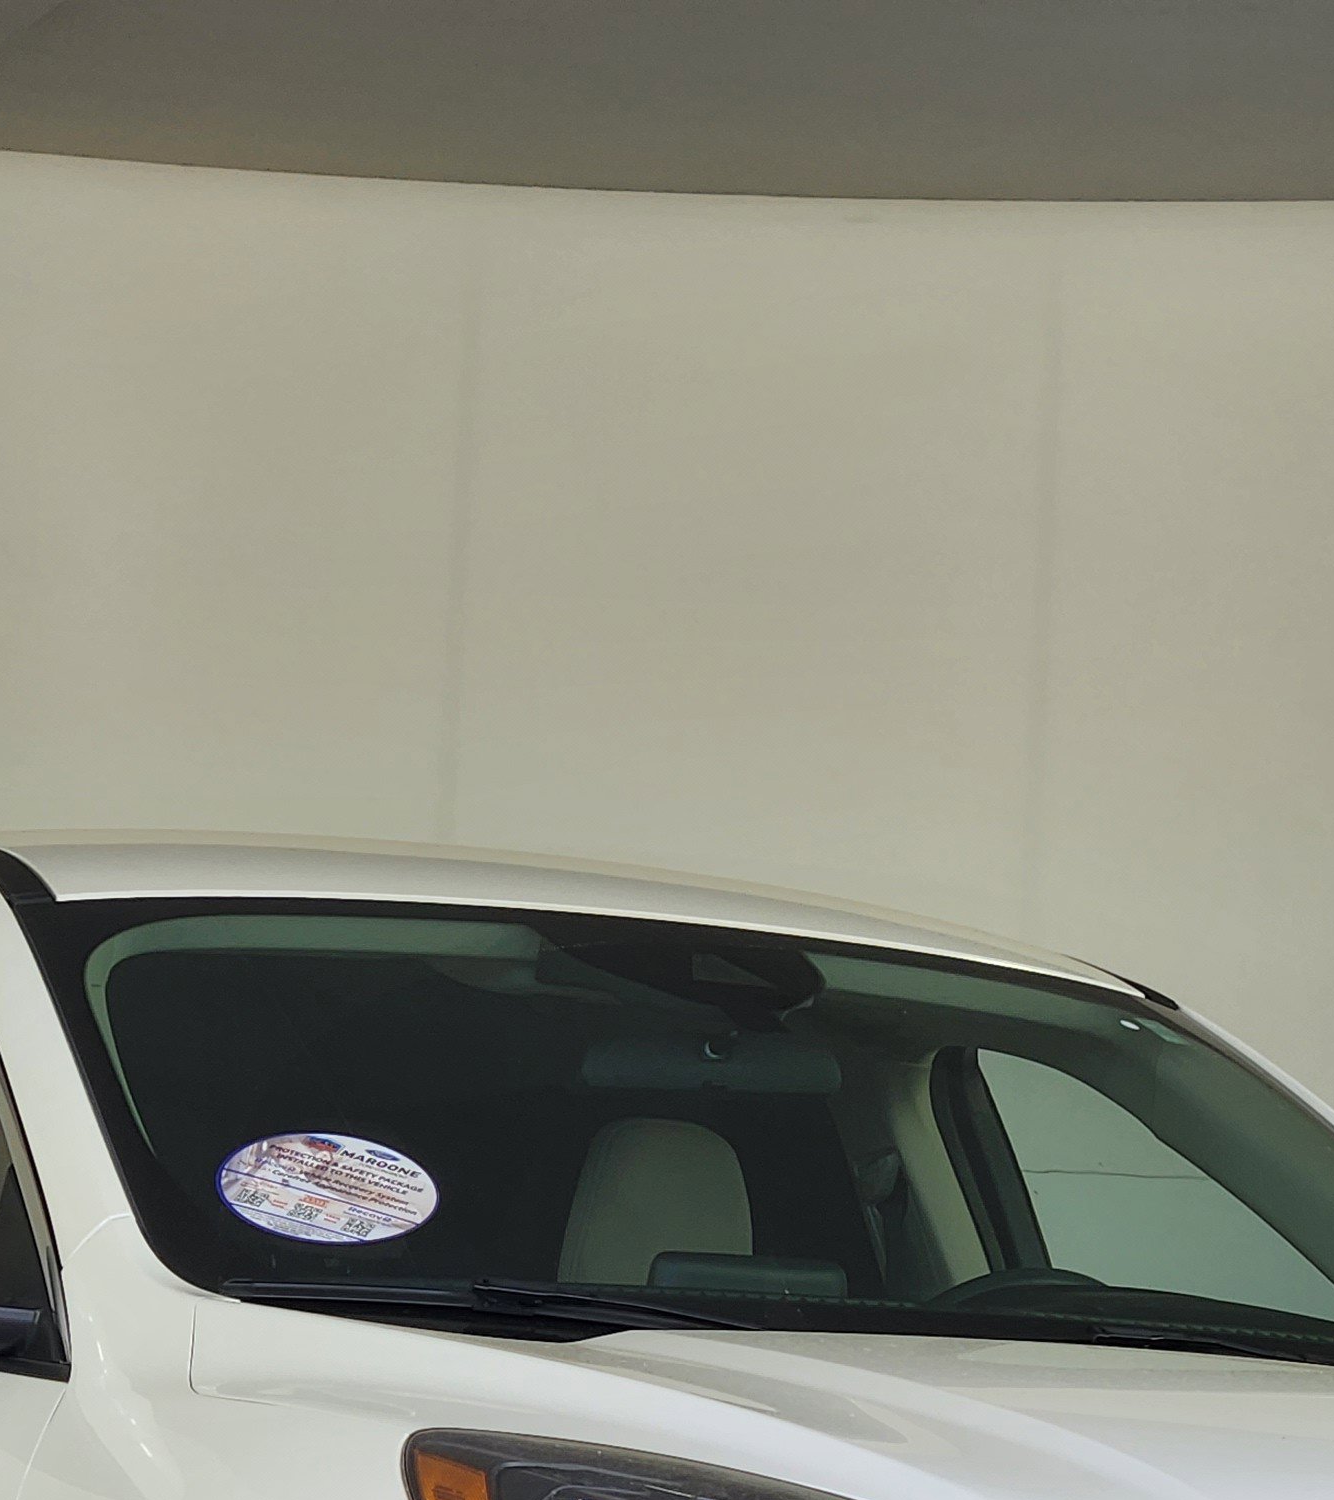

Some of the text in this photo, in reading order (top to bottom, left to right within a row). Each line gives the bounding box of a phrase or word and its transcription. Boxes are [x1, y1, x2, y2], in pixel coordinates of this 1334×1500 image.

[269, 1144, 329, 1165] PROTECTION
[340, 1165, 377, 1178] SAFETY
[377, 1175, 423, 1192] PACKAGE
[277, 1153, 327, 1171] INSTALLED
[329, 1168, 343, 1176] TO
[345, 1173, 367, 1183] THIS
[368, 1179, 409, 1195] VEHICLE
[340, 1149, 422, 1178] MAROONE
